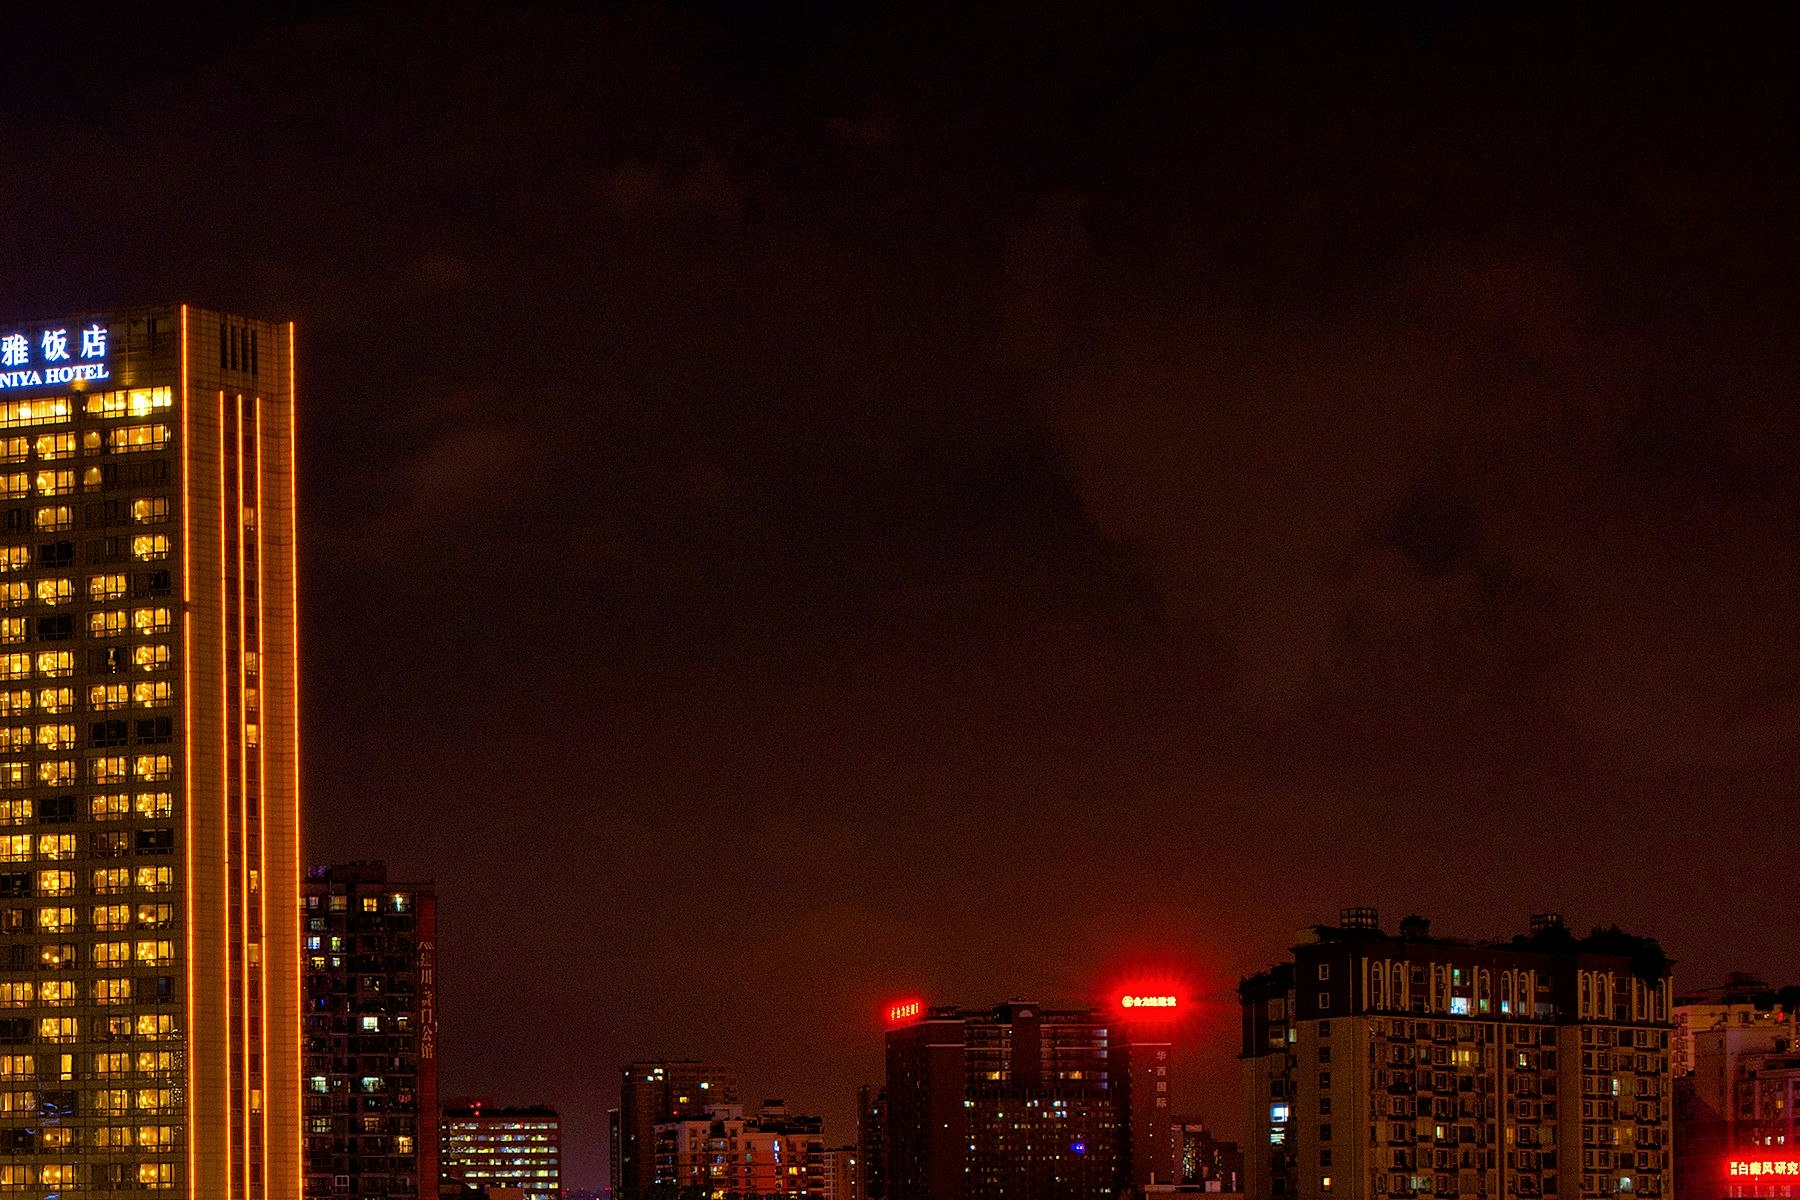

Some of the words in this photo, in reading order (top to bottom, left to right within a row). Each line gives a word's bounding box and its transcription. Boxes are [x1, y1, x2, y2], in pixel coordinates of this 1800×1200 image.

[45, 363, 110, 385] HOTEL
[1156, 1050, 1167, 1108] 华西国际
